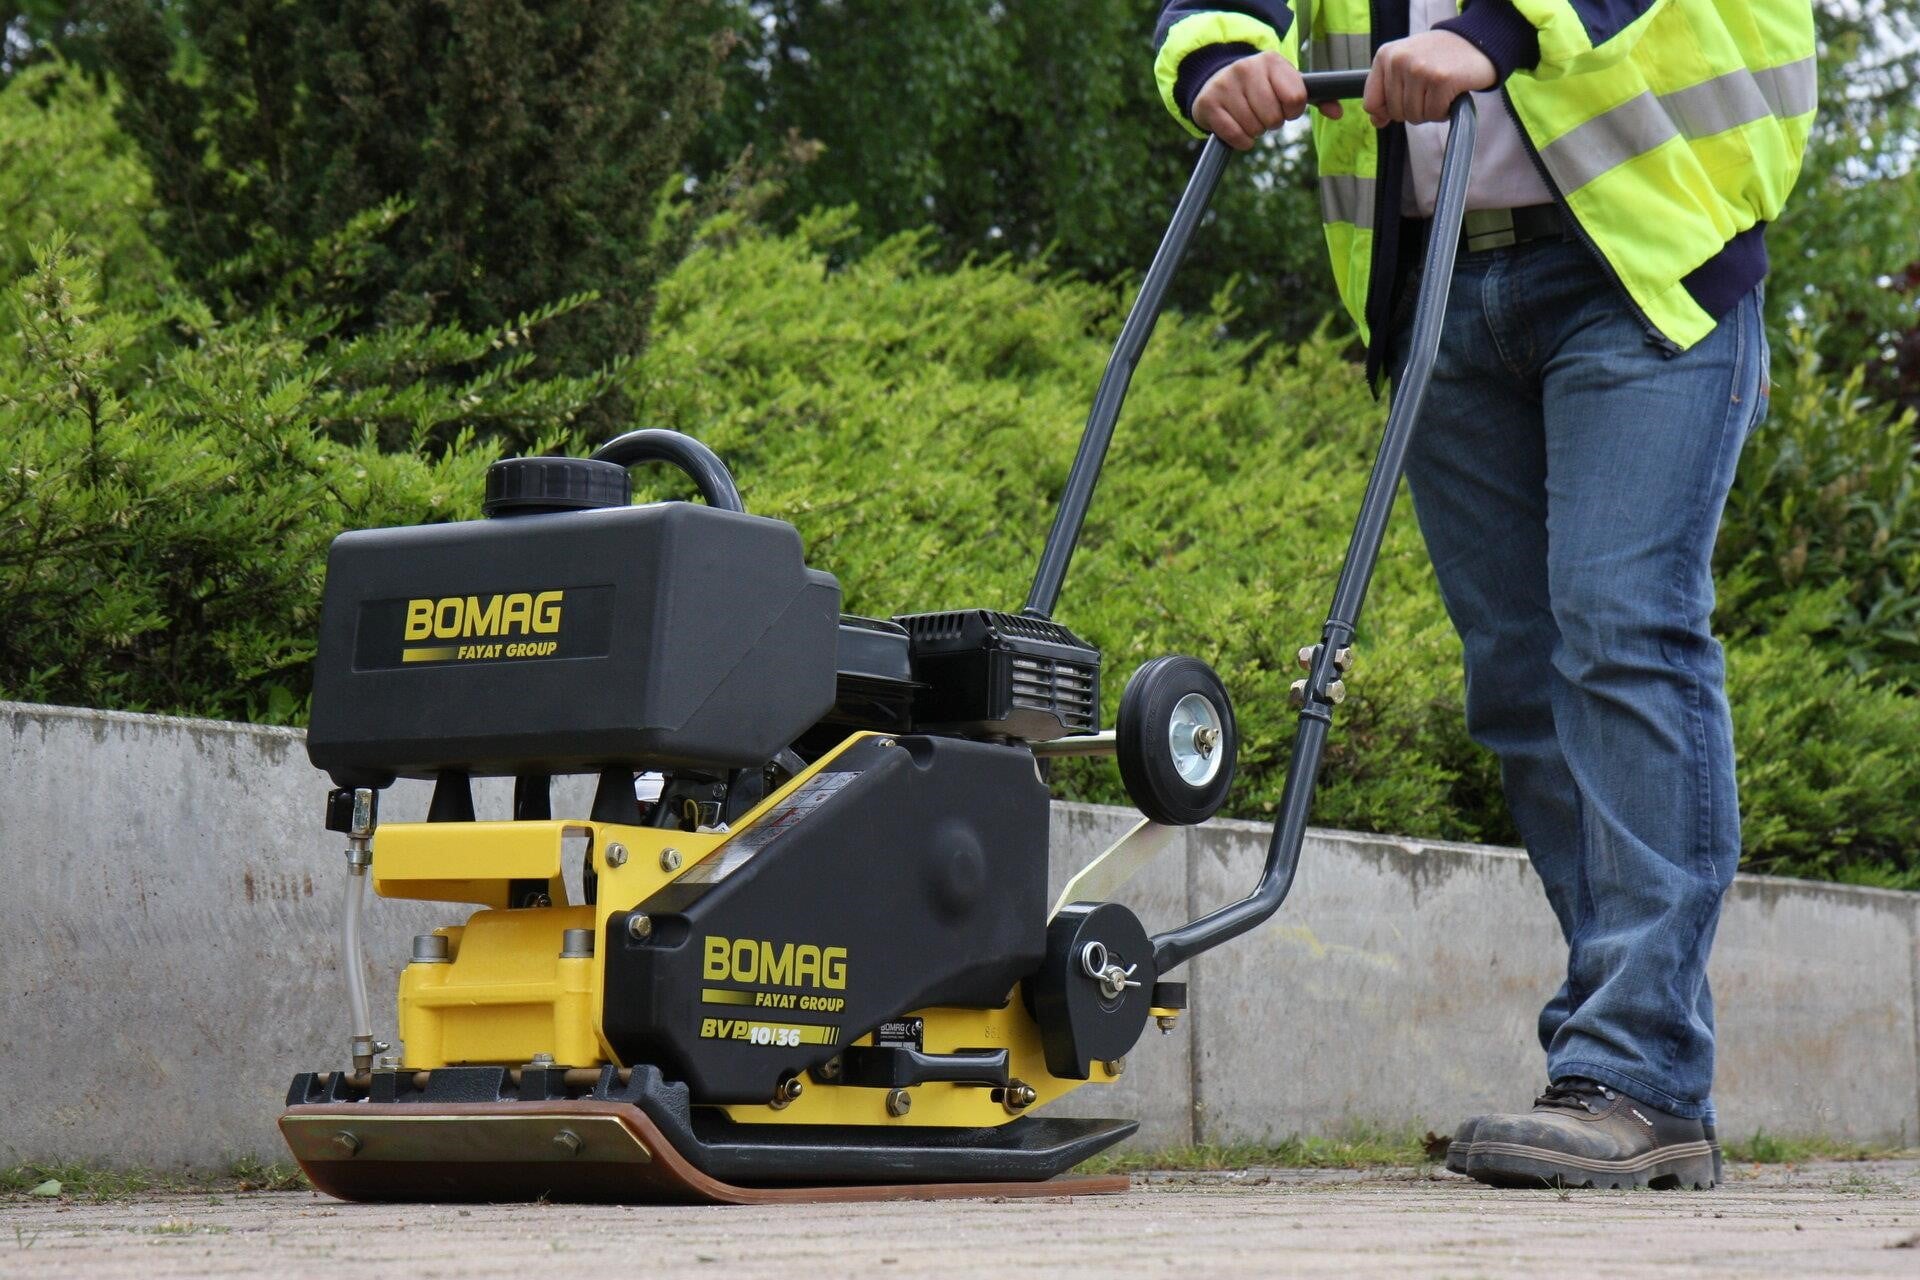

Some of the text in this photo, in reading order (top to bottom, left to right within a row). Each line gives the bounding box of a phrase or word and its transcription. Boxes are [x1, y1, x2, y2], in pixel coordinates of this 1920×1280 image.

[404, 590, 564, 641] BOMAG
[457, 641, 557, 660] FAYAT GROUP
[703, 935, 847, 990] BOMAG
[755, 992, 845, 1012] FAYAT GROUP
[700, 1018, 801, 1047] BVP 10/36
